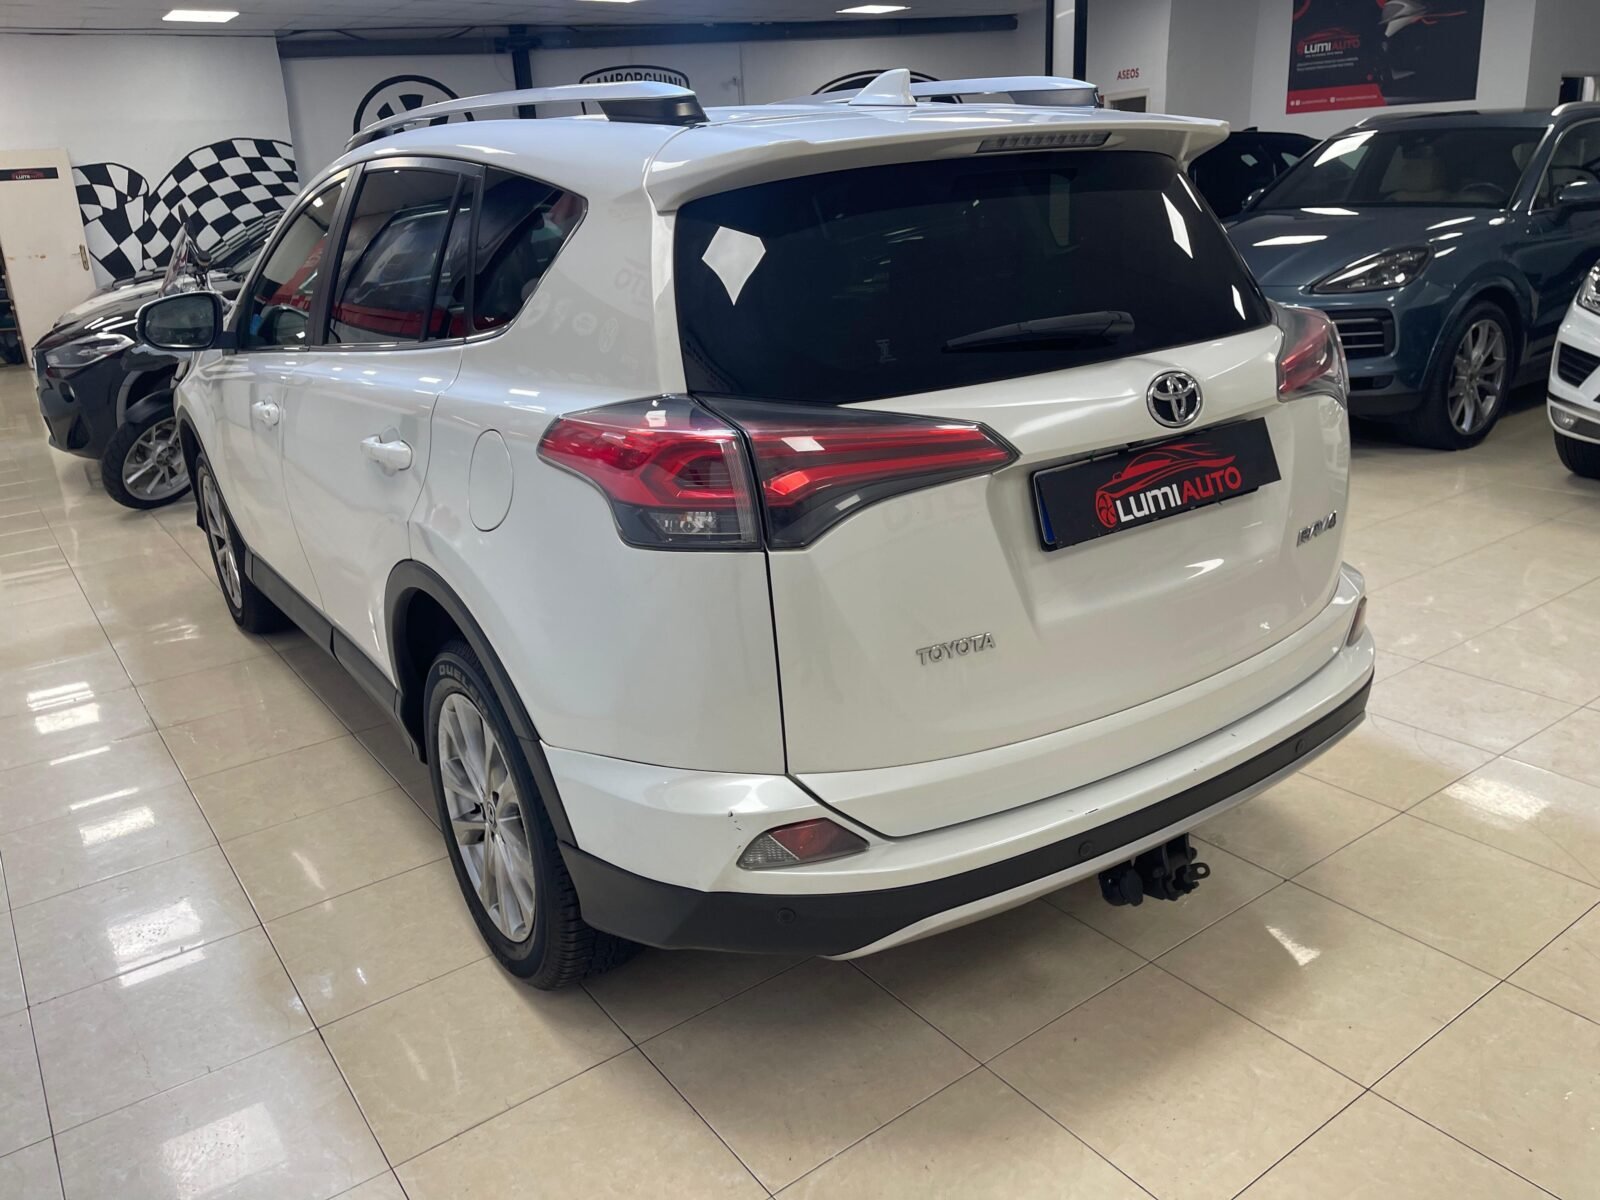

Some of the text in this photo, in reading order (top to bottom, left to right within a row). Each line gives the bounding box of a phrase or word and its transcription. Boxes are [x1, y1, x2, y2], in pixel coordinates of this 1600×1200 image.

[586, 71, 682, 88] AMBORGHINI
[1116, 67, 1140, 81] ASEOS
[915, 632, 996, 666] TOYOTA
